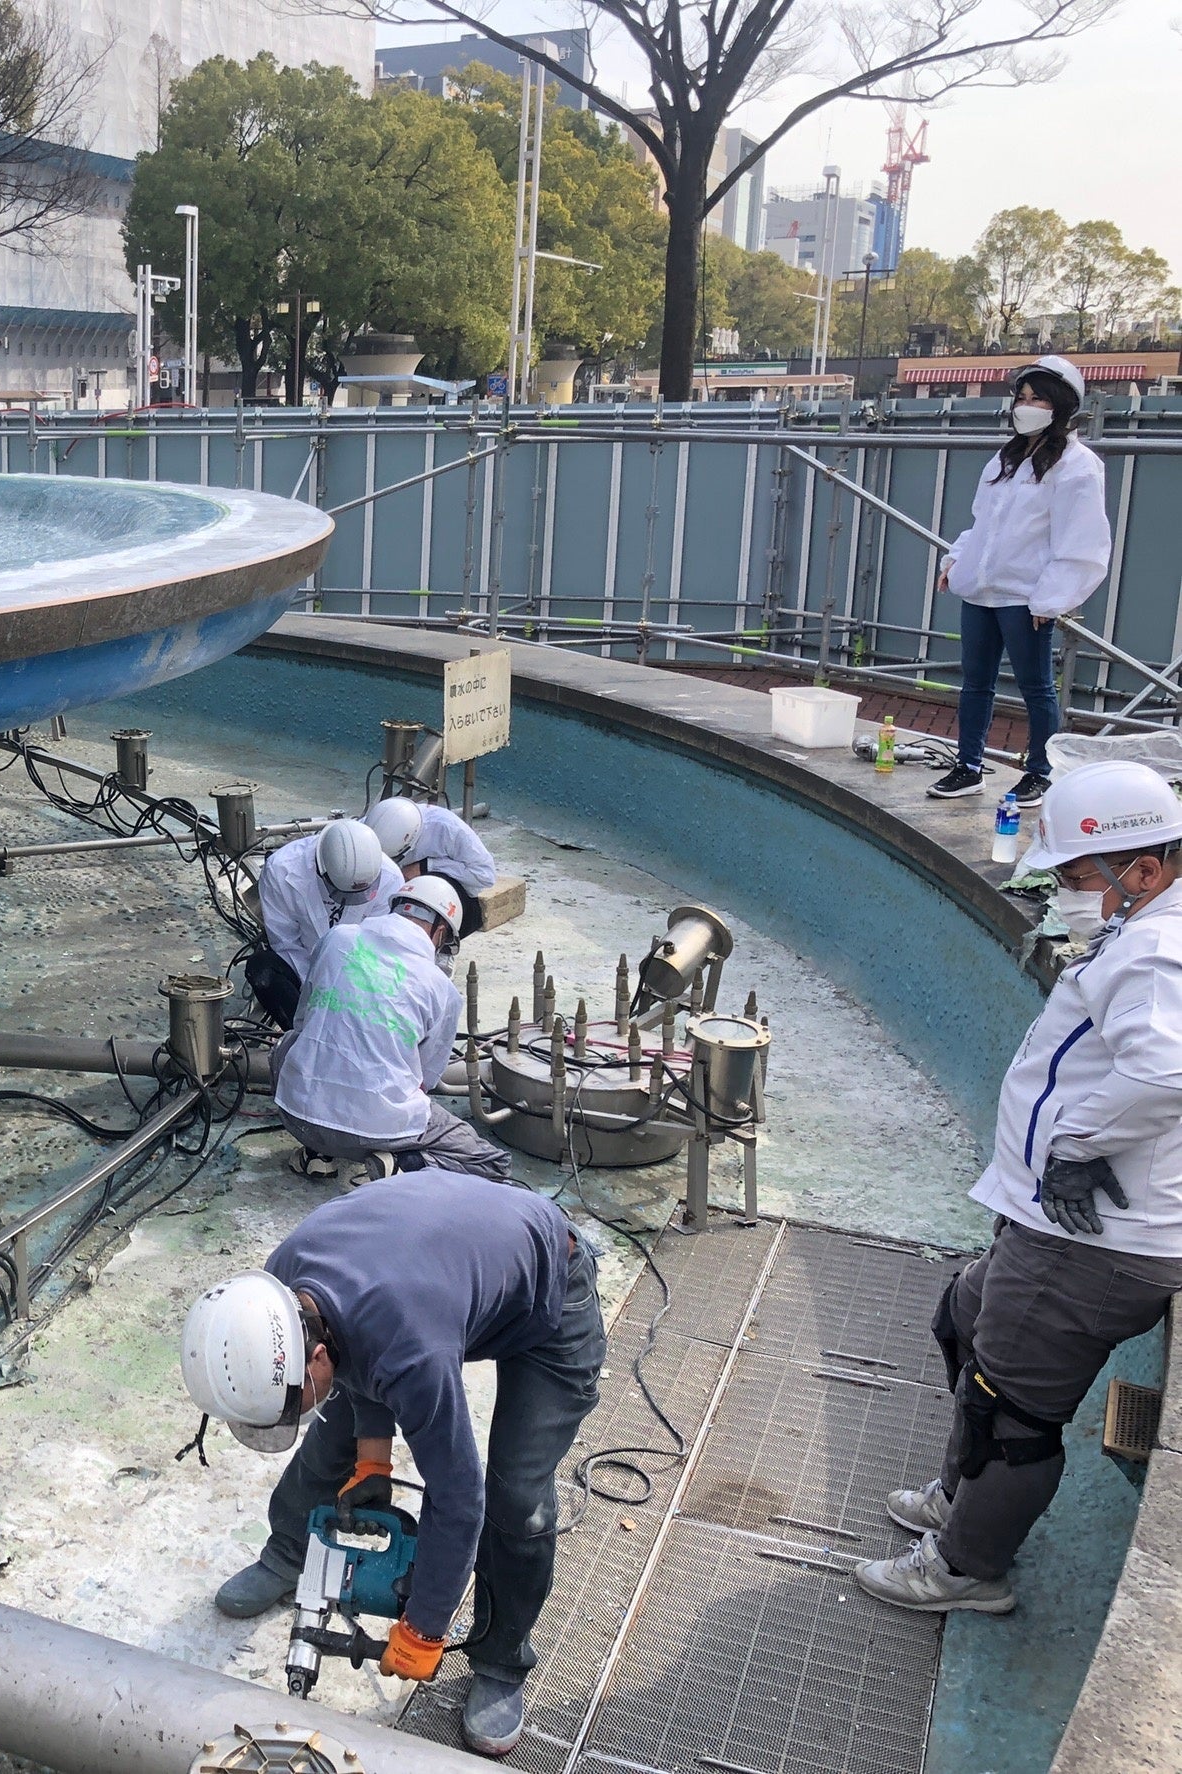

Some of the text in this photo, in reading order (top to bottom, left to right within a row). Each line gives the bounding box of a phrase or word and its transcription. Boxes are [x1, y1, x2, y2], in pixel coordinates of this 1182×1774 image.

[449, 703, 506, 732] 入らないで下さい
[1101, 814, 1164, 831] 日本塗装名人社
